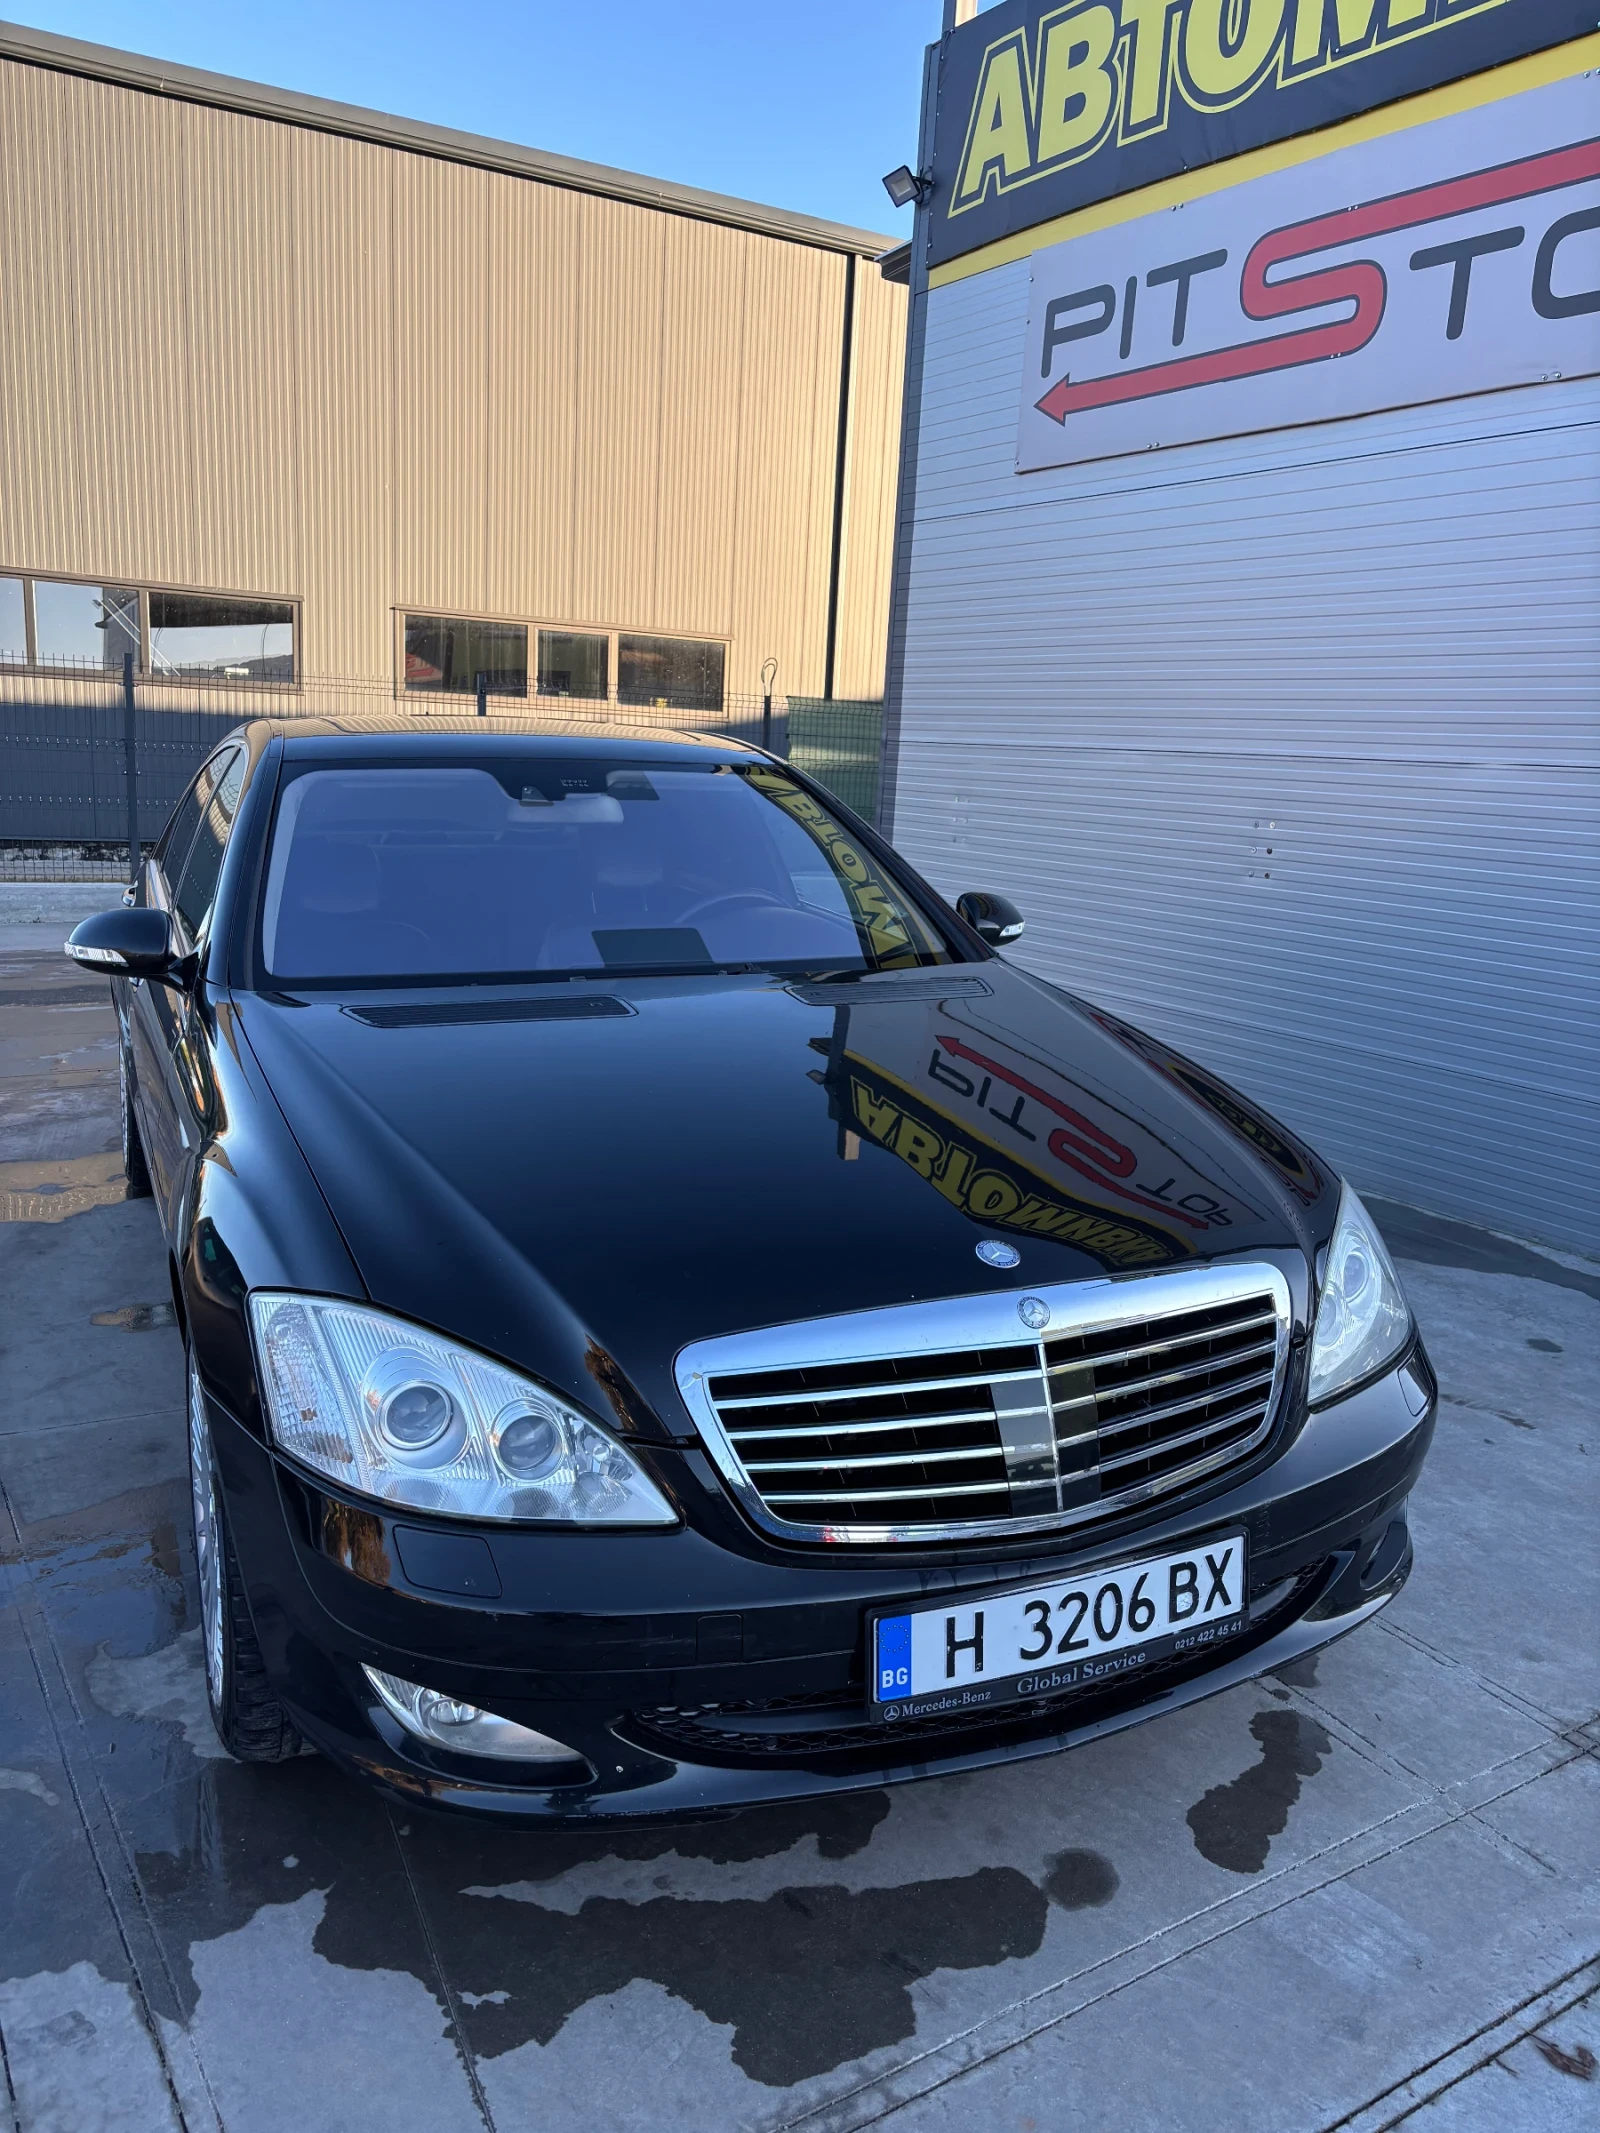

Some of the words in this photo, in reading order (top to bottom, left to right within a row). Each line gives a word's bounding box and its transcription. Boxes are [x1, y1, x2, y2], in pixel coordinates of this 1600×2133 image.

[946, 1611, 984, 1678] H
[1020, 1572, 1155, 1660] 3206
[1169, 1547, 1233, 1623] BX
[1175, 1636, 1195, 1650] 0212
[1197, 1629, 1215, 1642] 422
[1217, 1625, 1229, 1636] 45
[1232, 1620, 1242, 1632] 41
[882, 1667, 908, 1688] BG
[1017, 1667, 1077, 1694] Global
[1083, 1651, 1146, 1678] Service
[902, 1691, 991, 1717] Mercedes-Benz
